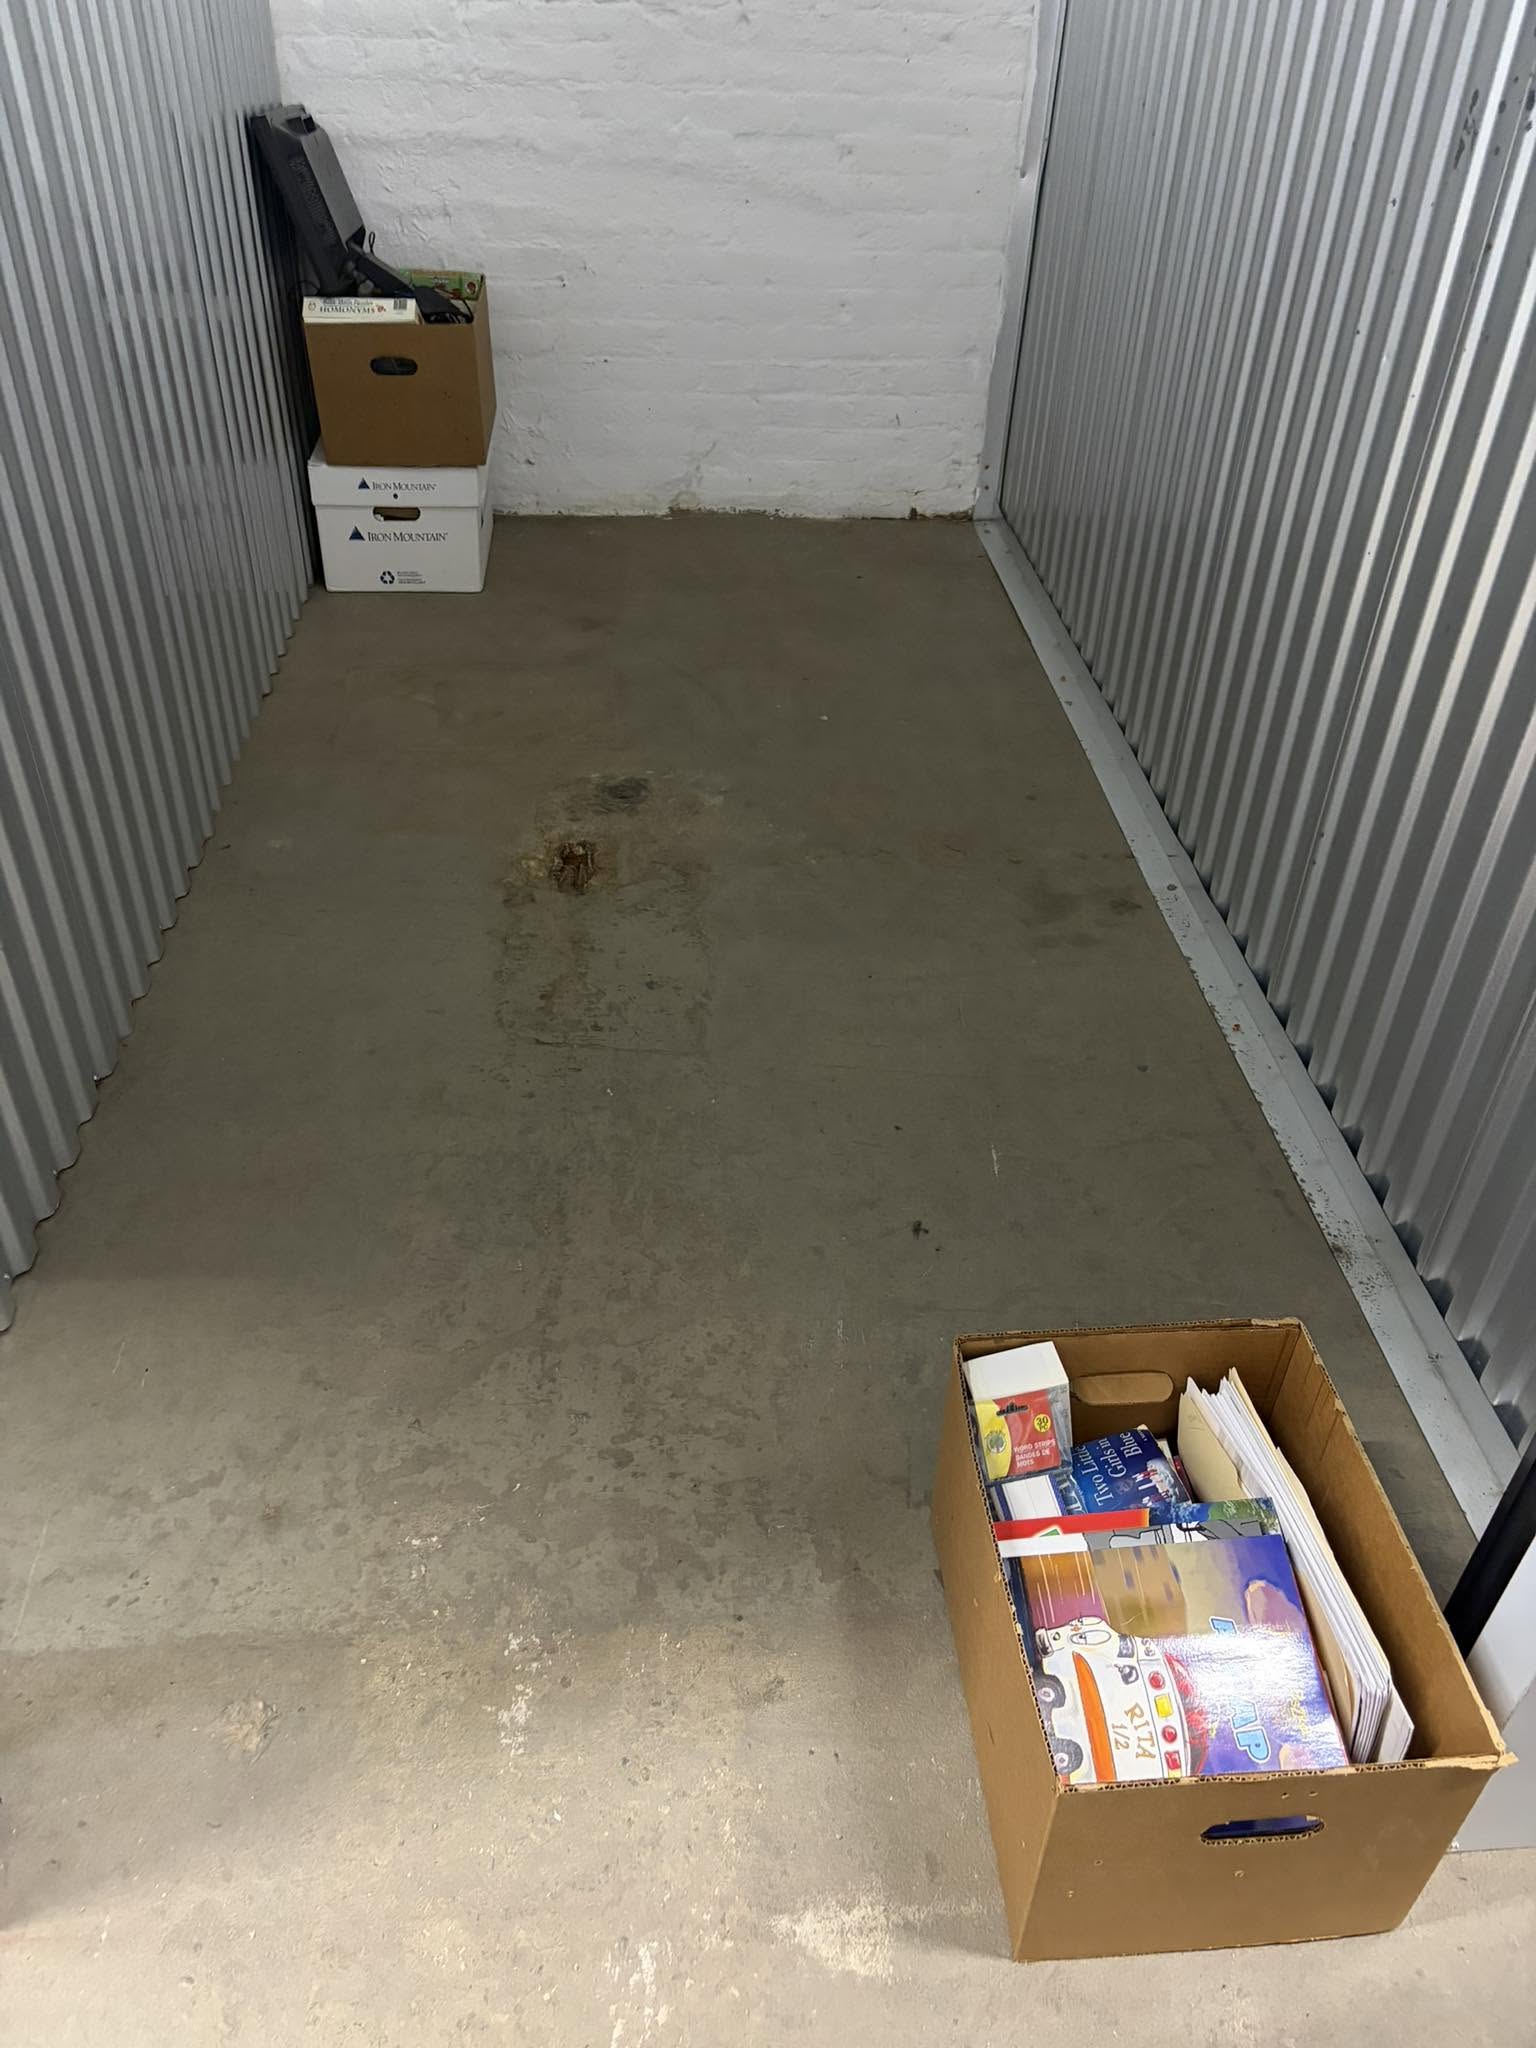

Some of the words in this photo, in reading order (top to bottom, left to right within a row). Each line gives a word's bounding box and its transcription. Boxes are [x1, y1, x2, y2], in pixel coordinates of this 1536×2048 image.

[372, 482, 392, 490] IRON
[393, 482, 435, 491] MOUNTAIN
[367, 531, 391, 541] IRON
[393, 531, 446, 542] MOUNTAIN
[1036, 1416, 1049, 1425] 30
[1014, 1443, 1033, 1453] WORD
[1034, 1438, 1056, 1448] STRIPS
[1041, 1447, 1051, 1456] DE
[1096, 1438, 1111, 1450] in
[1119, 1432, 1143, 1458] Blue
[1075, 1445, 1099, 1475] Little
[1100, 1448, 1127, 1478] Girls
[1092, 1474, 1114, 1506] Two
[1111, 1721, 1130, 1750] 1/2
[1124, 1702, 1156, 1759] RITA
